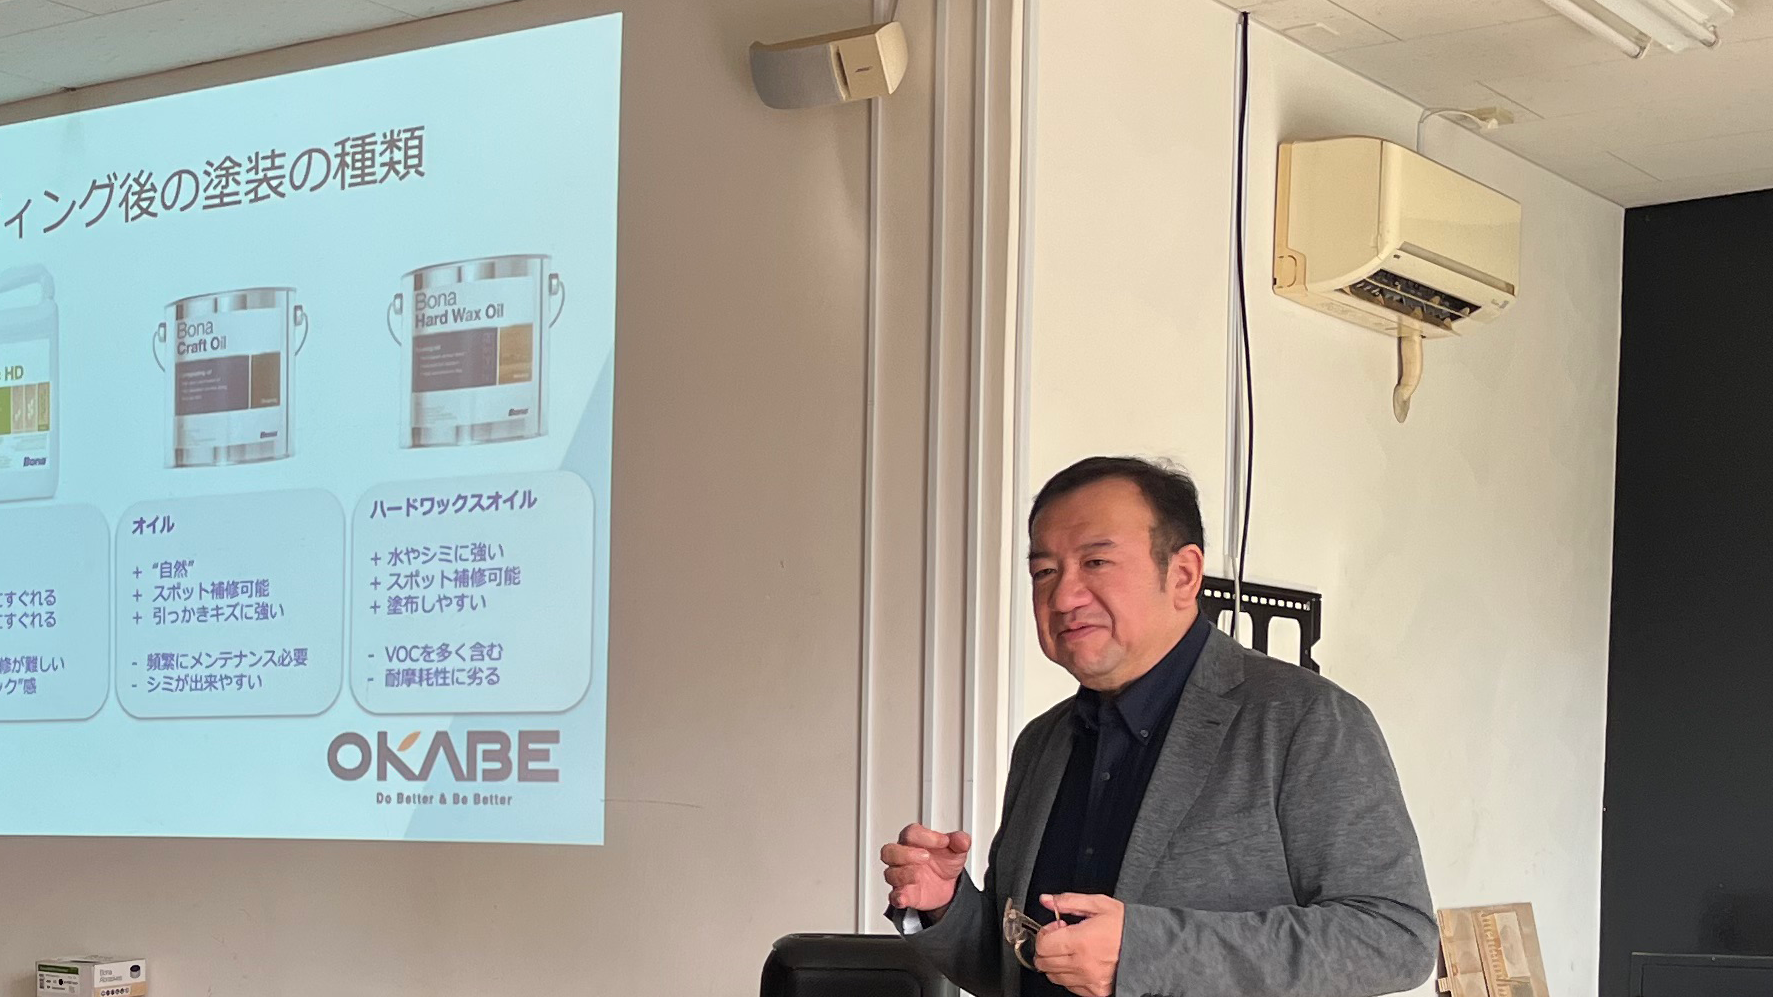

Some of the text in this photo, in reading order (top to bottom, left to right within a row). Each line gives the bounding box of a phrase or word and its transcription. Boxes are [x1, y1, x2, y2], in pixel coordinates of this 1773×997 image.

[415, 291, 457, 312] Bona
[415, 303, 504, 329] Hard Wax Oil
[177, 321, 214, 339] Bona
[177, 336, 226, 355] Craft Oil
[4, 365, 24, 381] HD
[370, 489, 538, 518] ハードワックスオイル
[131, 515, 175, 535] オイル
[387, 542, 504, 567] 水やシミに強い
[386, 565, 521, 591] スポット補修可能
[152, 579, 270, 602] スポット補修可能
[152, 601, 284, 625] 引っかきキズに強い
[387, 593, 487, 615] 塗布しやすい
[146, 648, 308, 671] 頻繁にメンテナンス必要
[385, 642, 504, 663] VOCを多く含む
[147, 673, 263, 693] シミが出来やすい
[385, 666, 501, 687] 耐摩耗性に劣る
[327, 729, 560, 782] OKABE
[376, 792, 513, 806] Do Better & Be Better
